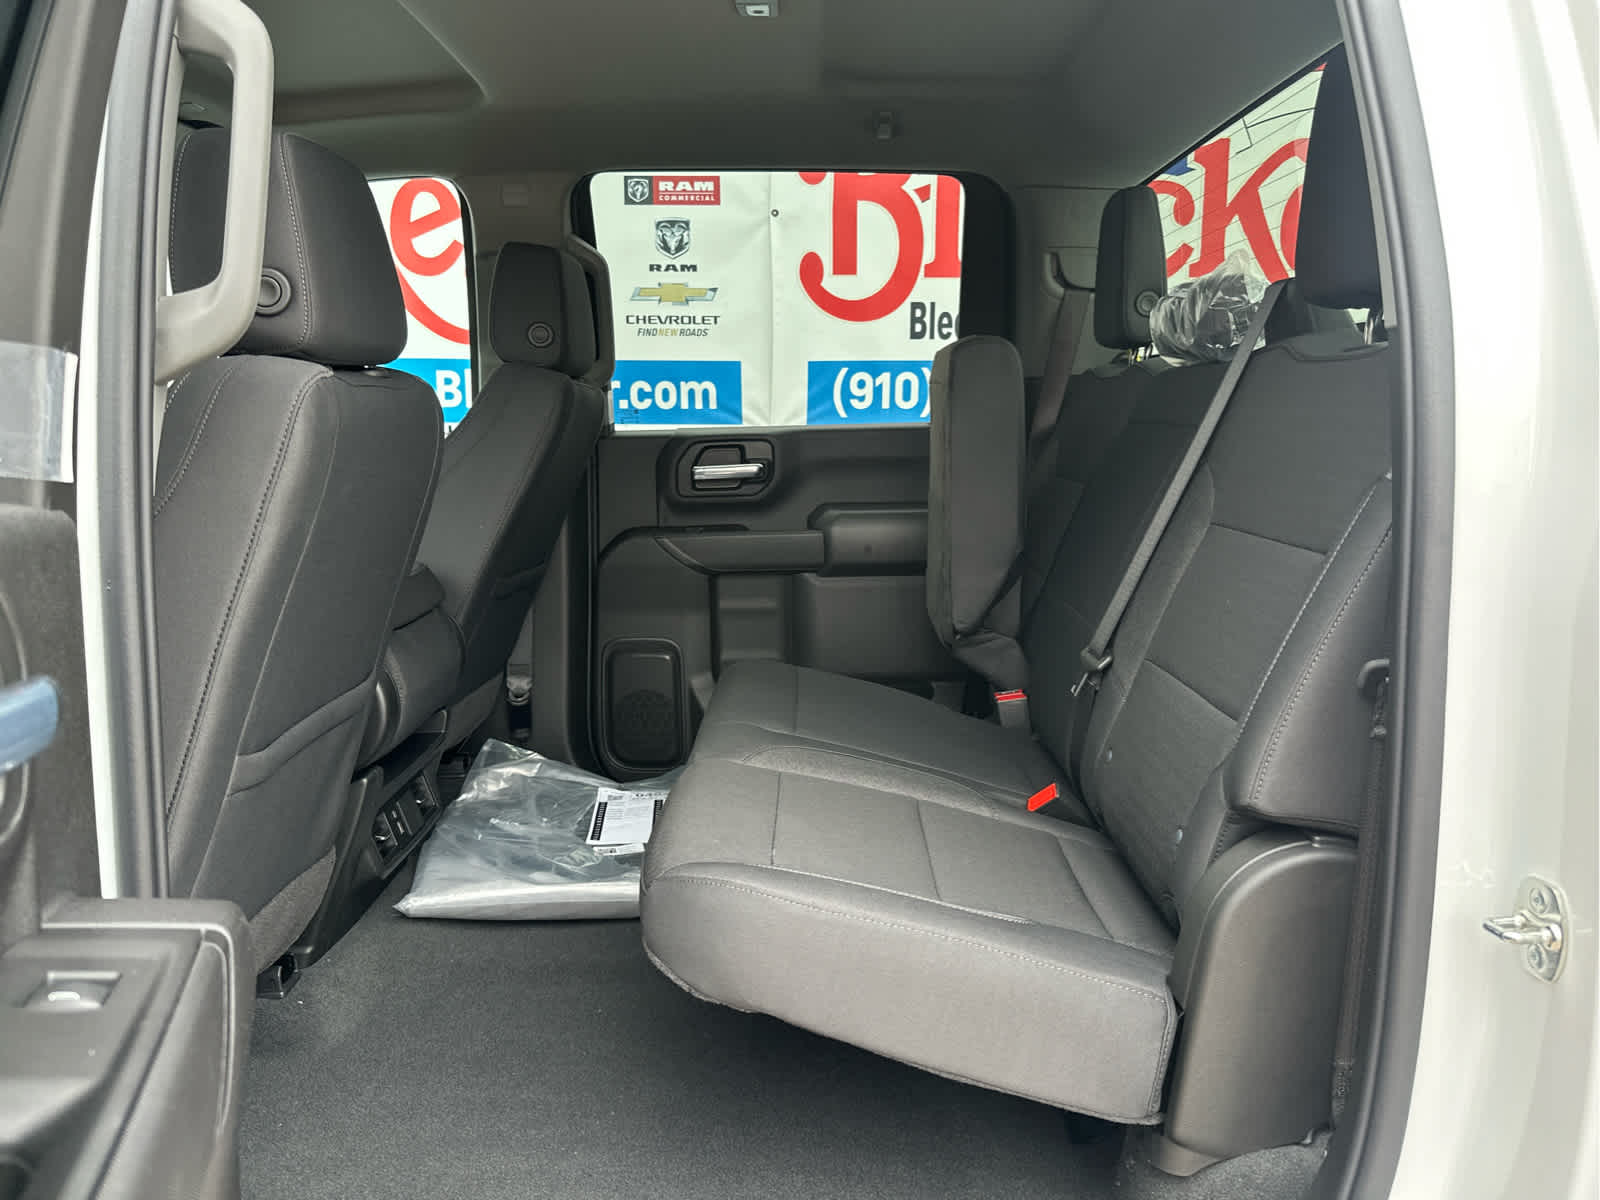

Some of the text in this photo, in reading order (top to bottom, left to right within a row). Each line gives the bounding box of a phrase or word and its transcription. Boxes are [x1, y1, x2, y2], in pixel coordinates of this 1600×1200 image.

[659, 181, 714, 191] RAM
[649, 264, 697, 272] RAM
[626, 315, 720, 325] CHEVROLET
[910, 302, 960, 340] Ble
